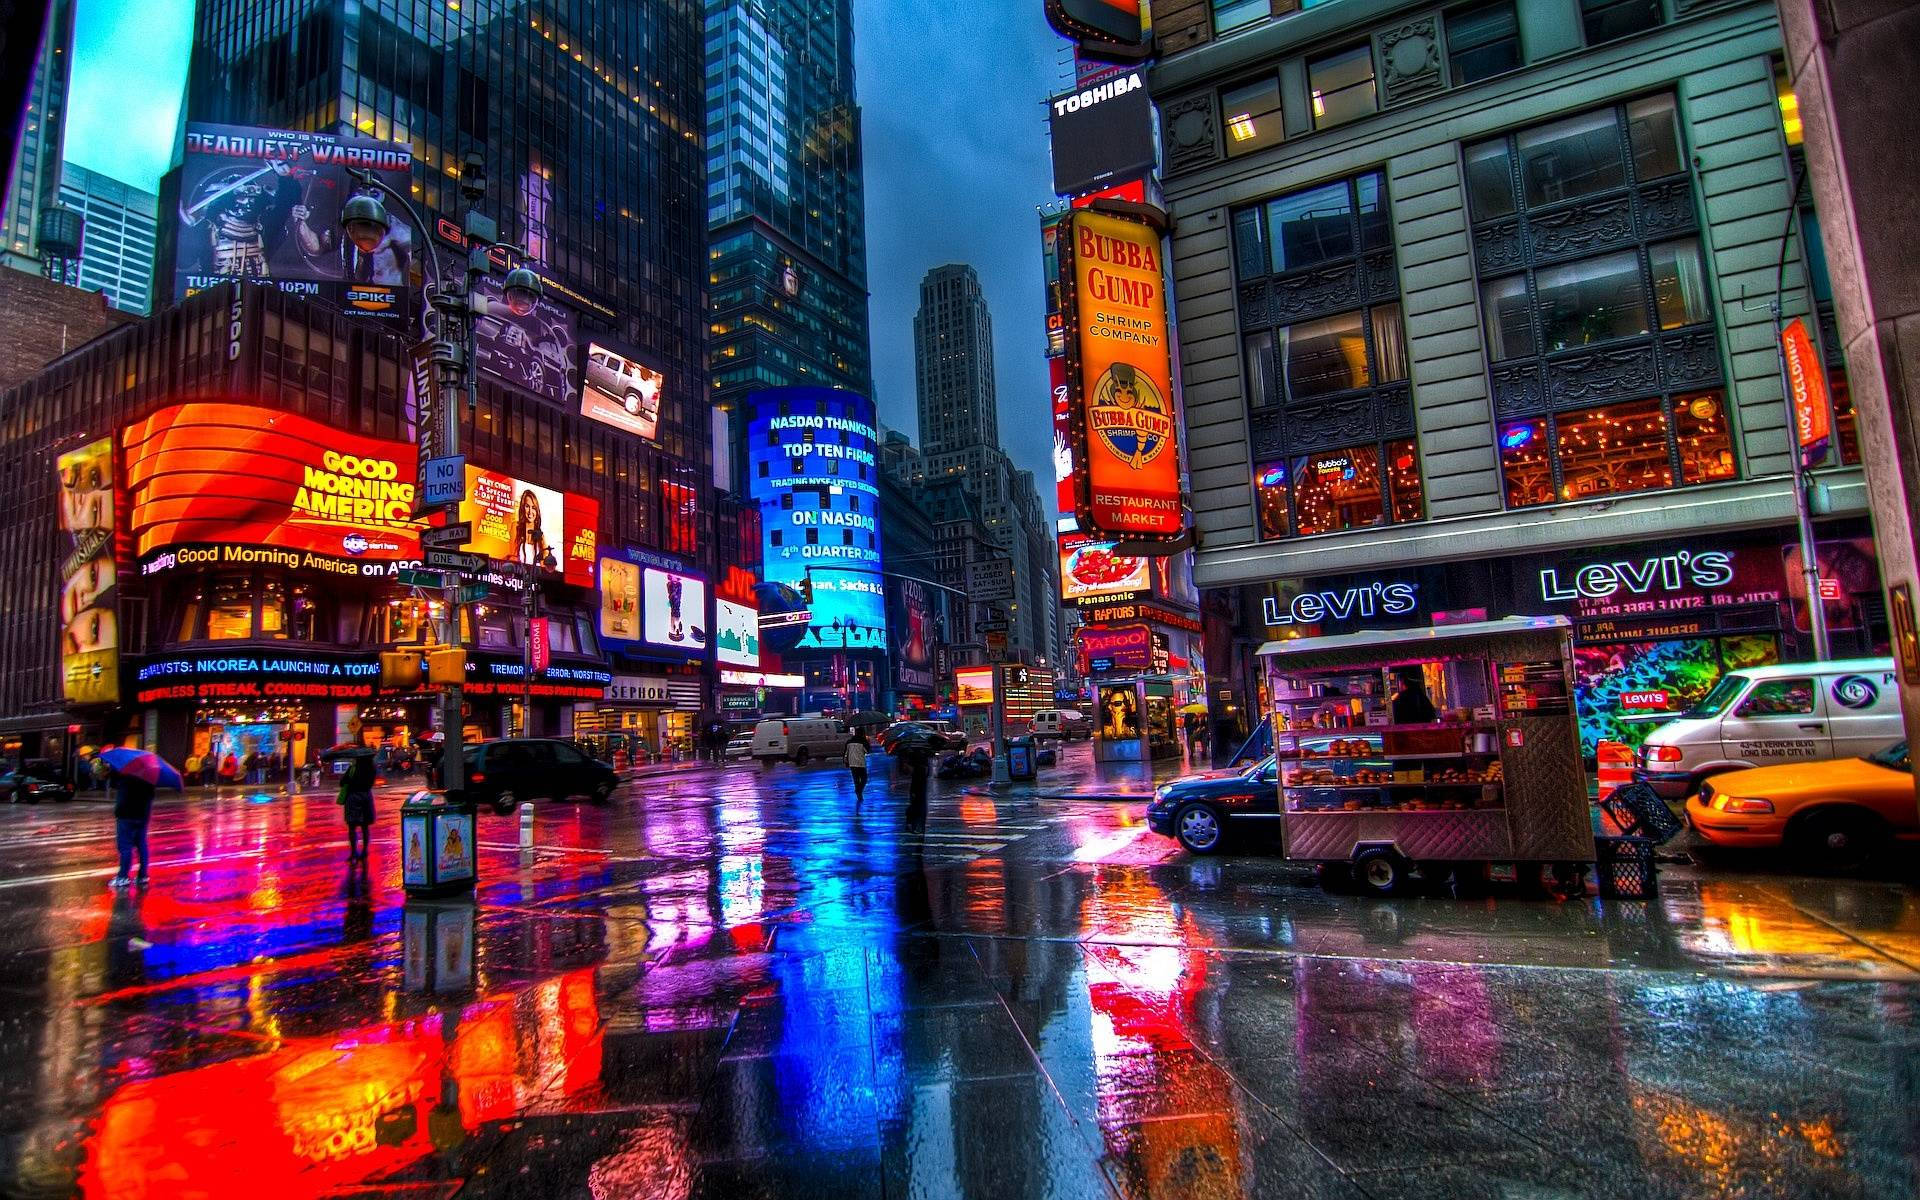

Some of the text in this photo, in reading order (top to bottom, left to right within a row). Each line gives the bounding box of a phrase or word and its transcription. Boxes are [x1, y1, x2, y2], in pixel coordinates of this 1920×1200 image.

[1054, 73, 1142, 116] TOSHIBA
[268, 131, 336, 143] WHO IS THE
[187, 133, 412, 171] DEADLIEST WARRIOR
[1093, 171, 1113, 181] TOSHIBA
[1078, 225, 1158, 273] BUBBA
[279, 281, 319, 295] 10PM
[541, 276, 593, 306] PROFESSIONAL
[1088, 268, 1154, 309] GUMP
[346, 291, 396, 302] SPIKE
[229, 281, 241, 360] 1500
[1096, 312, 1152, 330] SHRIMP
[1089, 325, 1159, 346] COMPANY
[414, 357, 432, 427] VENIT
[770, 416, 823, 430] NASDAQ
[824, 417, 867, 436] THANKS
[1092, 410, 1169, 435] BUBBA GUMP
[1107, 429, 1158, 442] SHRIMP CO
[783, 443, 875, 467] TOP TEN FIRMS
[323, 450, 398, 480] GOOD
[1318, 458, 1348, 469] Bubba's
[437, 465, 454, 478] NO
[304, 465, 415, 502] MORNING
[428, 481, 464, 496] TURNS
[771, 478, 808, 487] TRADING
[1095, 494, 1177, 511] RESTAURANT
[484, 513, 503, 524] GOOD
[792, 511, 875, 533] ON NASDAQ
[1111, 511, 1165, 526] MARKET
[449, 530, 465, 538] WAY
[478, 525, 511, 539] AMERICA
[343, 536, 369, 550] abc
[433, 553, 480, 567] ONE WAY
[781, 545, 799, 559] 4th
[801, 545, 863, 560] QUARTER
[177, 546, 219, 564] Good
[224, 546, 299, 569] Morning
[303, 553, 358, 575] America
[362, 564, 384, 576] on
[410, 570, 417, 584] 7
[724, 564, 756, 600] JVC
[974, 571, 1003, 580] CLOSED
[839, 579, 869, 592] Sachs
[869, 582, 877, 594] &
[1077, 591, 1135, 605] Panasonic
[1094, 606, 1135, 621] RAPTORS
[533, 621, 541, 669] WELCOME
[1084, 630, 1146, 650] YAHOO!
[197, 660, 259, 672] NKOREA
[262, 660, 312, 673] LAUNCH
[313, 663, 330, 674] NOT
[332, 665, 341, 675] A
[490, 663, 524, 675] TREMOR
[198, 683, 261, 698] STREAK,
[264, 682, 329, 697] CONQUERS
[329, 685, 372, 697] TEXAS
[611, 685, 672, 700] SEPHORA
[1740, 741, 1762, 749] 43-43
[1764, 740, 1794, 749] VERNON
[1740, 749, 1760, 758] LONG
[1761, 749, 1786, 757] ISLAND
